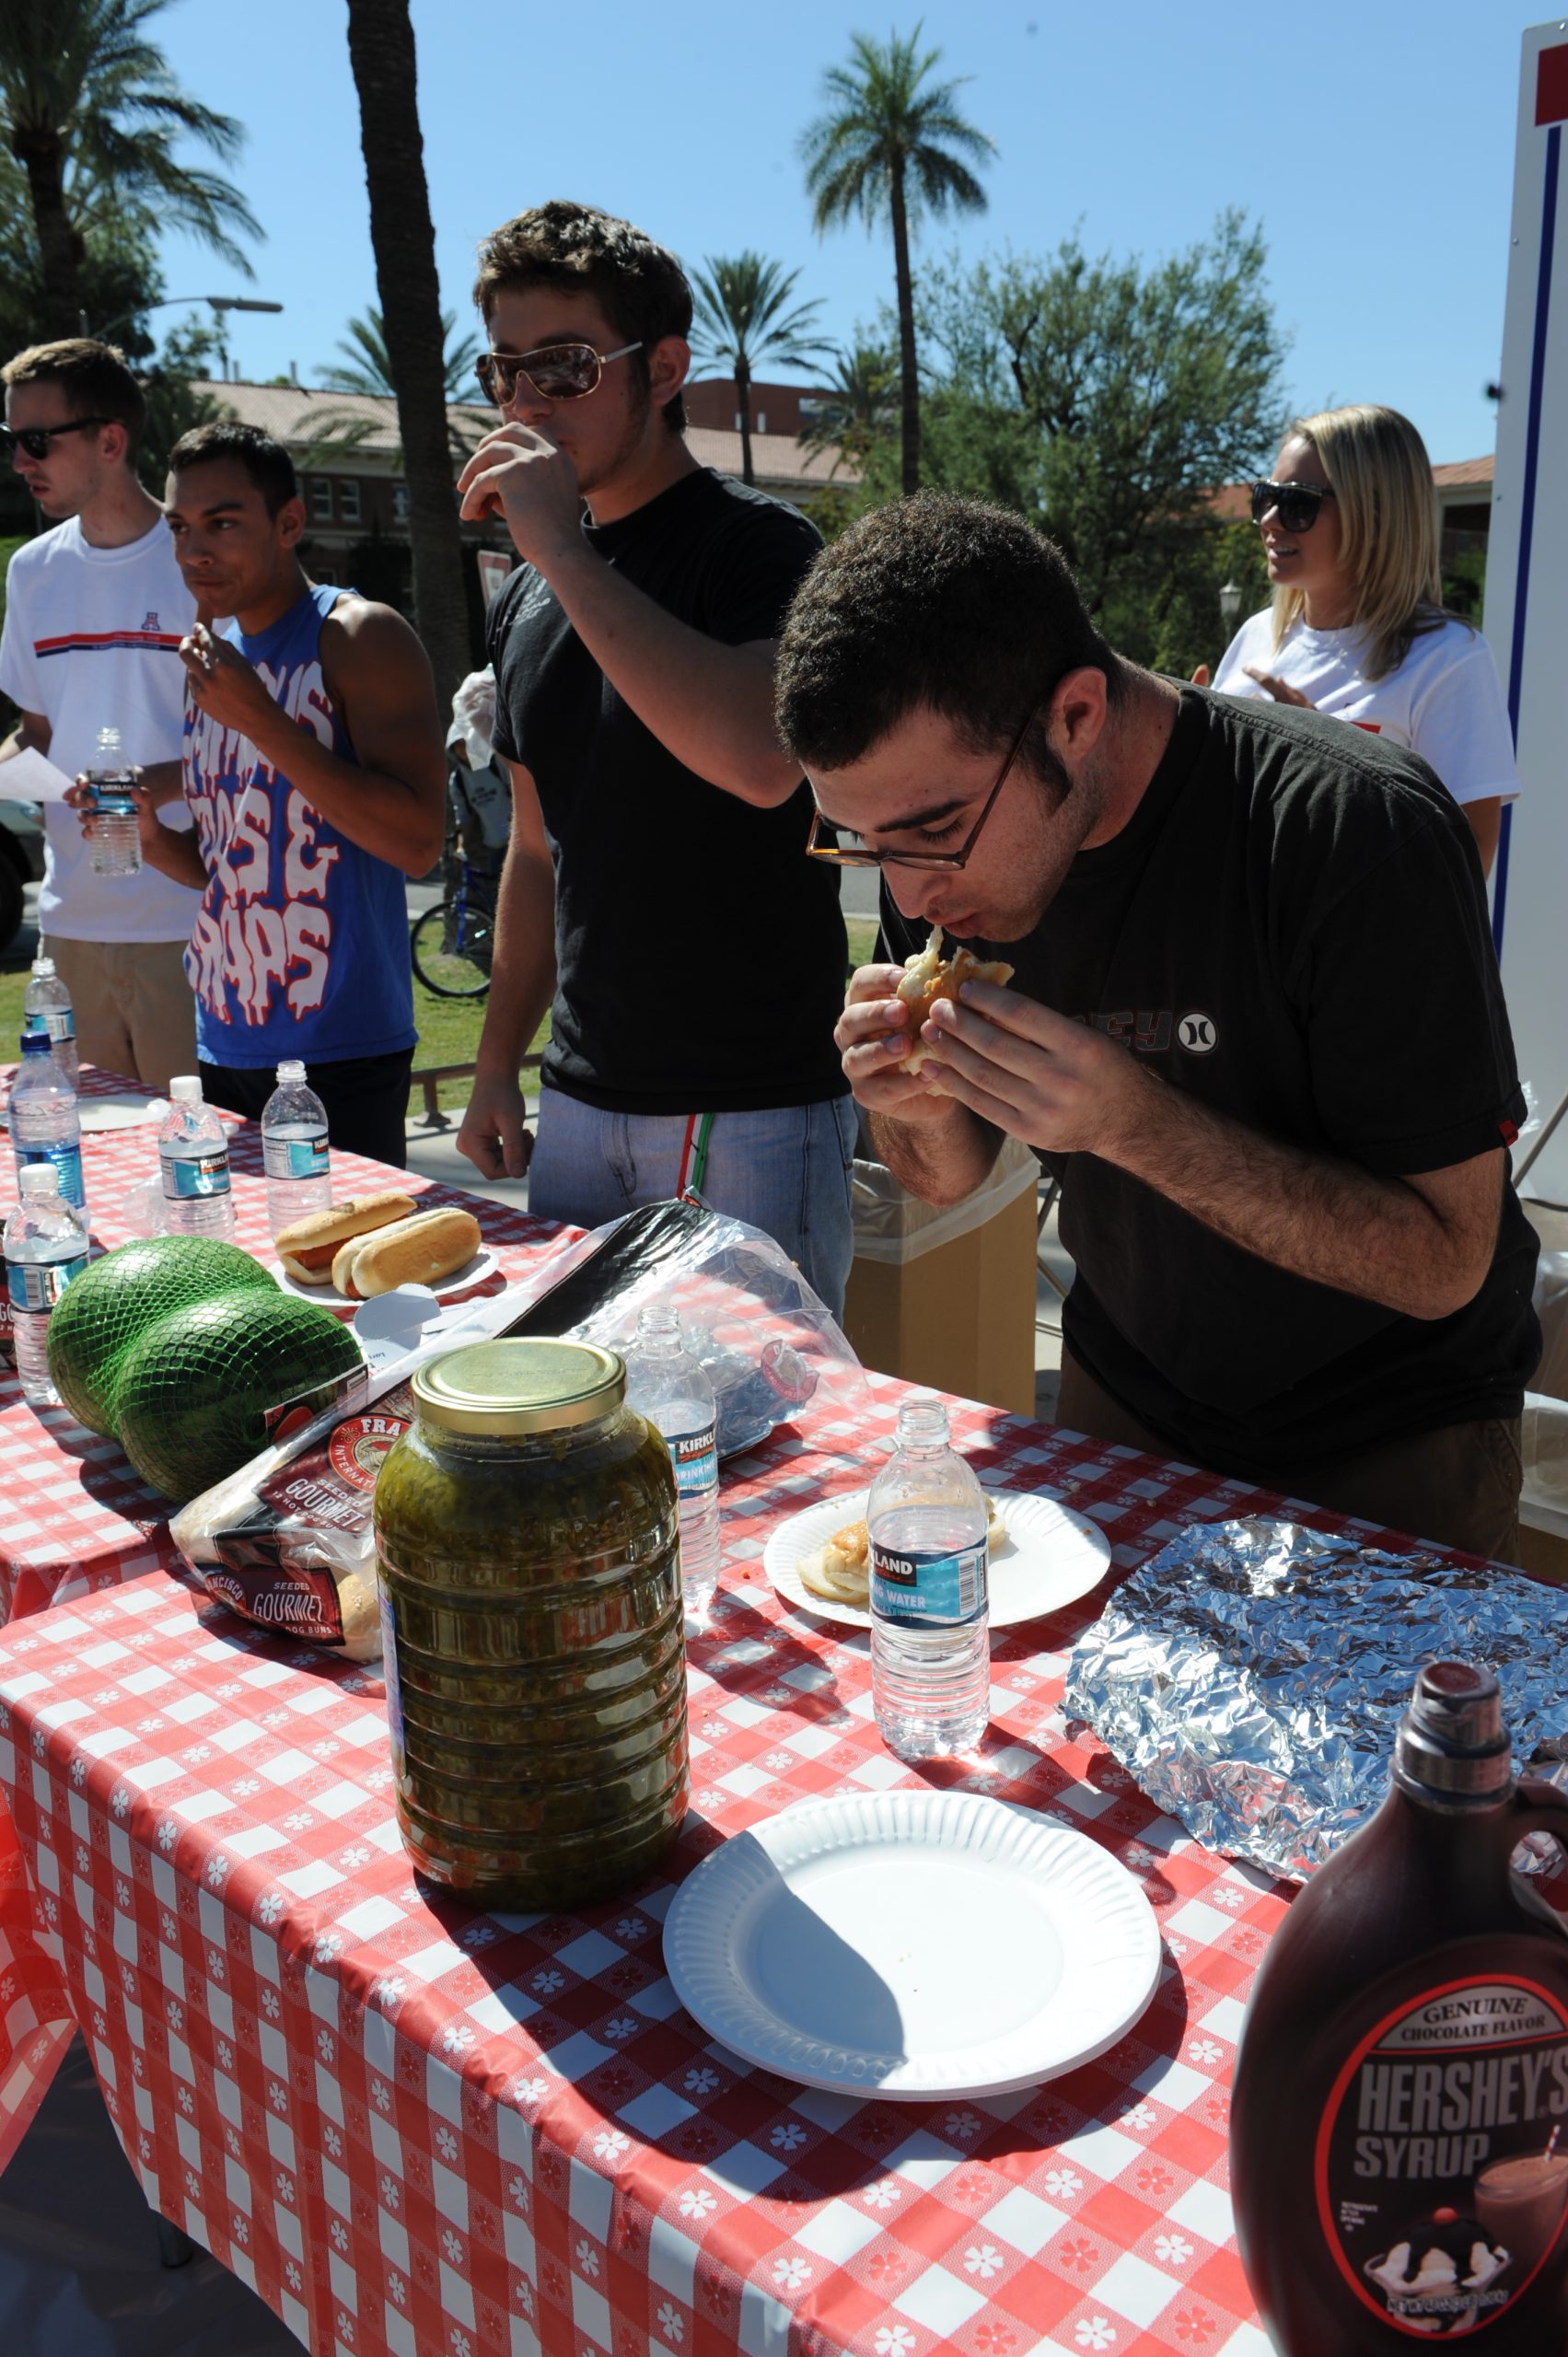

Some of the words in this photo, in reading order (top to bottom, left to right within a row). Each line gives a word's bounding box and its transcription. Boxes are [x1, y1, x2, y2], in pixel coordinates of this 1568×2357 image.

[283, 1497, 302, 1513] HOT
[285, 1478, 366, 1527] GOURMET
[317, 1479, 362, 1508] SEEDED
[874, 1550, 913, 1575] LAND
[273, 1582, 310, 1591] SEEDED
[887, 1589, 926, 1608] WATER
[253, 1593, 323, 1622] GOURMET
[308, 1625, 332, 1634] BUNS
[1423, 1997, 1528, 2025] GENUINE
[1400, 2023, 1491, 2042] CHOCOLATE
[1493, 2014, 1547, 2035] FLAVOR
[1353, 2132, 1490, 2179] SYRUP
